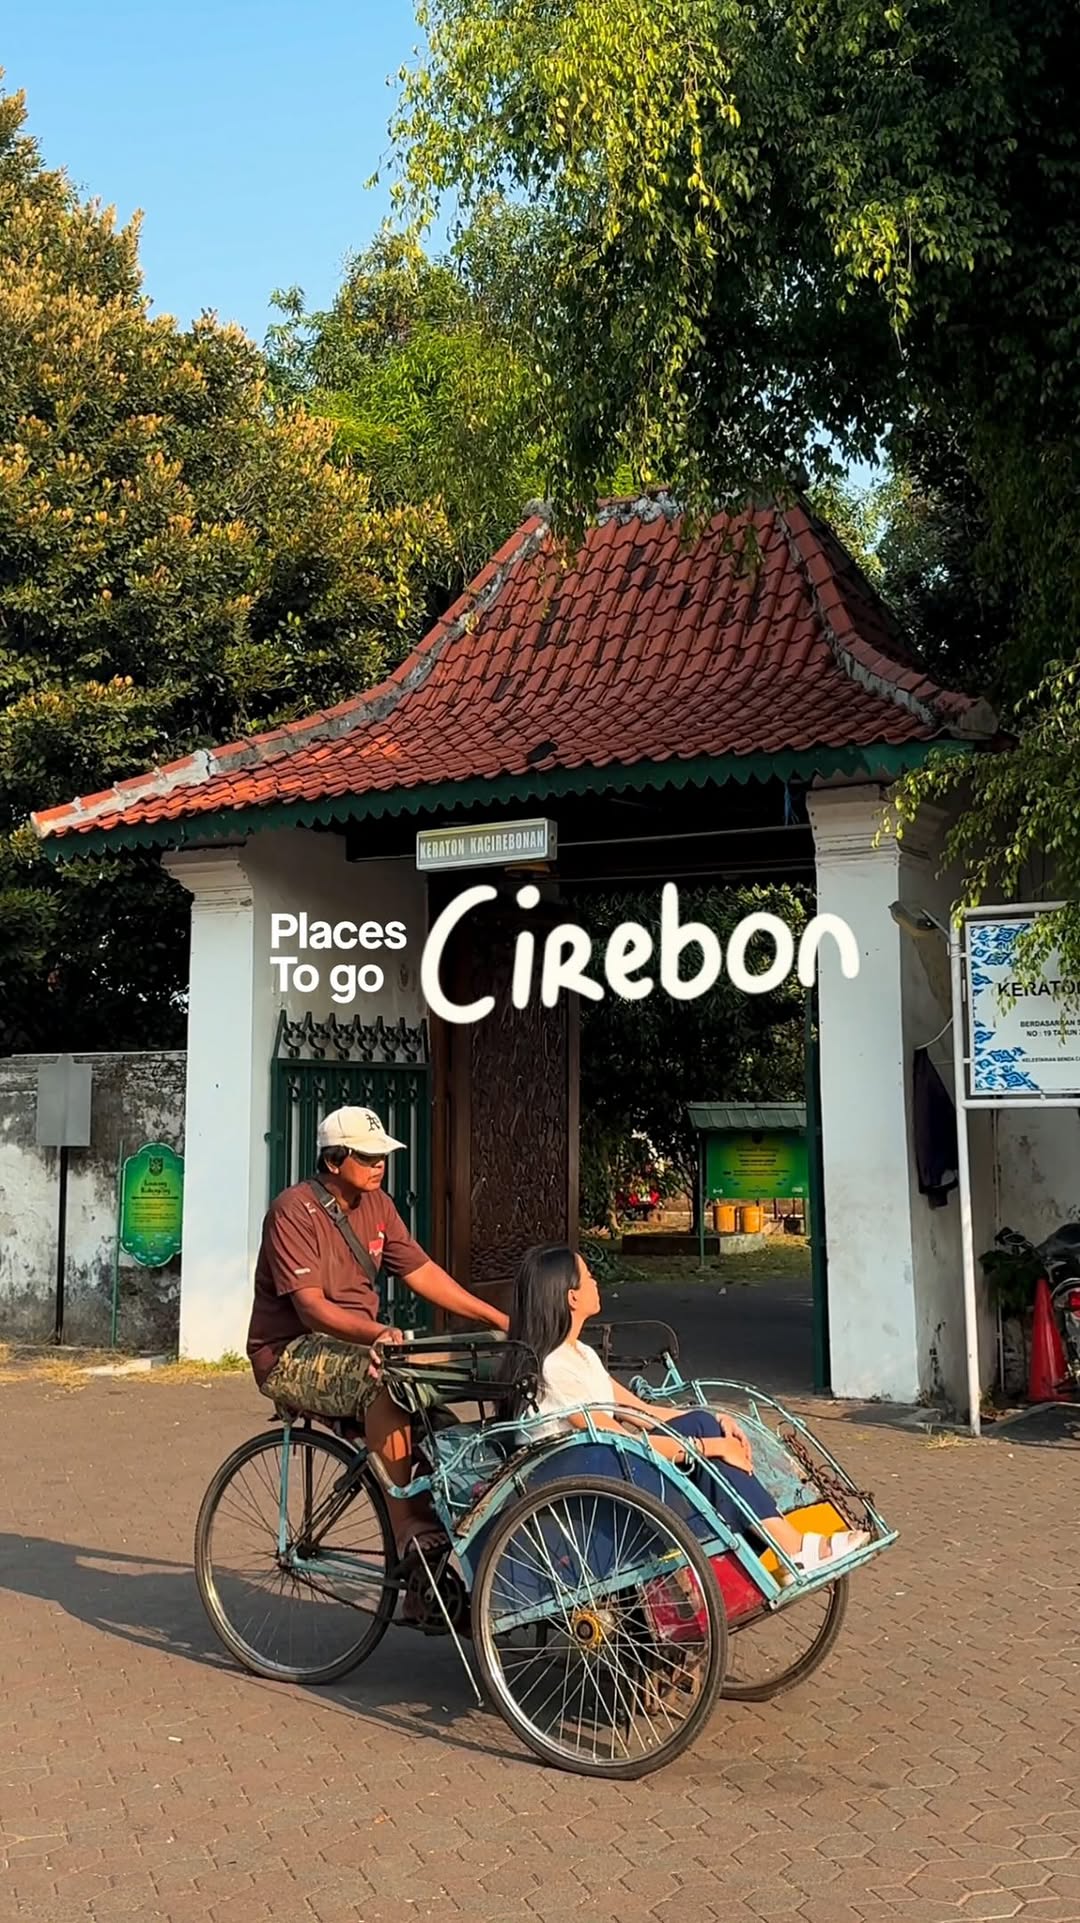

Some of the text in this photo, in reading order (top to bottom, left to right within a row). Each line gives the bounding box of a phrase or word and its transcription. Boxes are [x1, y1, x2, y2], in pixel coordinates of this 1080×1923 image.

[419, 830, 544, 859] KERATON KACIREBONAN
[997, 980, 1080, 997] KERATO
